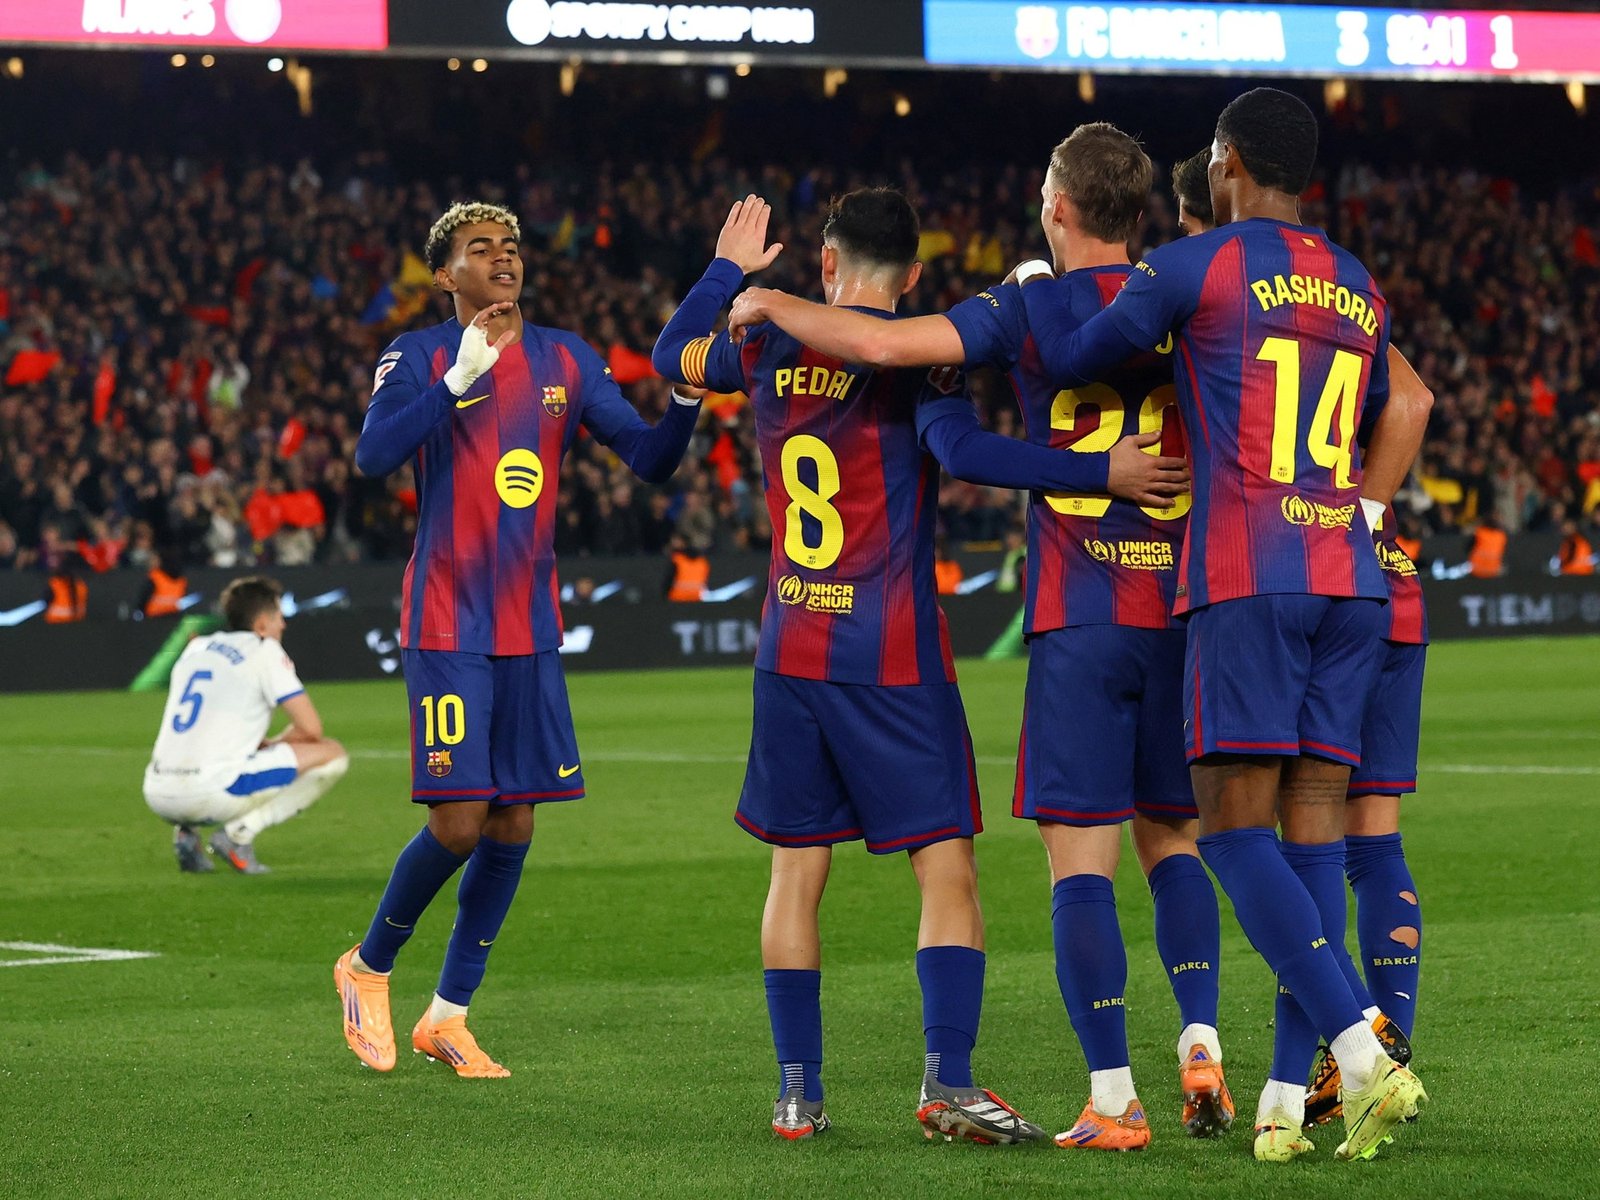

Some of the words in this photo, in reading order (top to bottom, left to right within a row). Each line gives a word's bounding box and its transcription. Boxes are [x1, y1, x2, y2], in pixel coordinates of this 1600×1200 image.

[1336, 11, 1369, 66] 3
[1490, 15, 1518, 69] 1
[1251, 275, 1379, 337] RASHFORD
[775, 366, 856, 401] PEDRI
[1256, 337, 1363, 490] 14
[780, 434, 844, 570] 8
[1118, 541, 1172, 554] UNHCR
[1120, 553, 1174, 565] ACNUR
[172, 670, 213, 734] 5
[420, 693, 466, 747] 10
